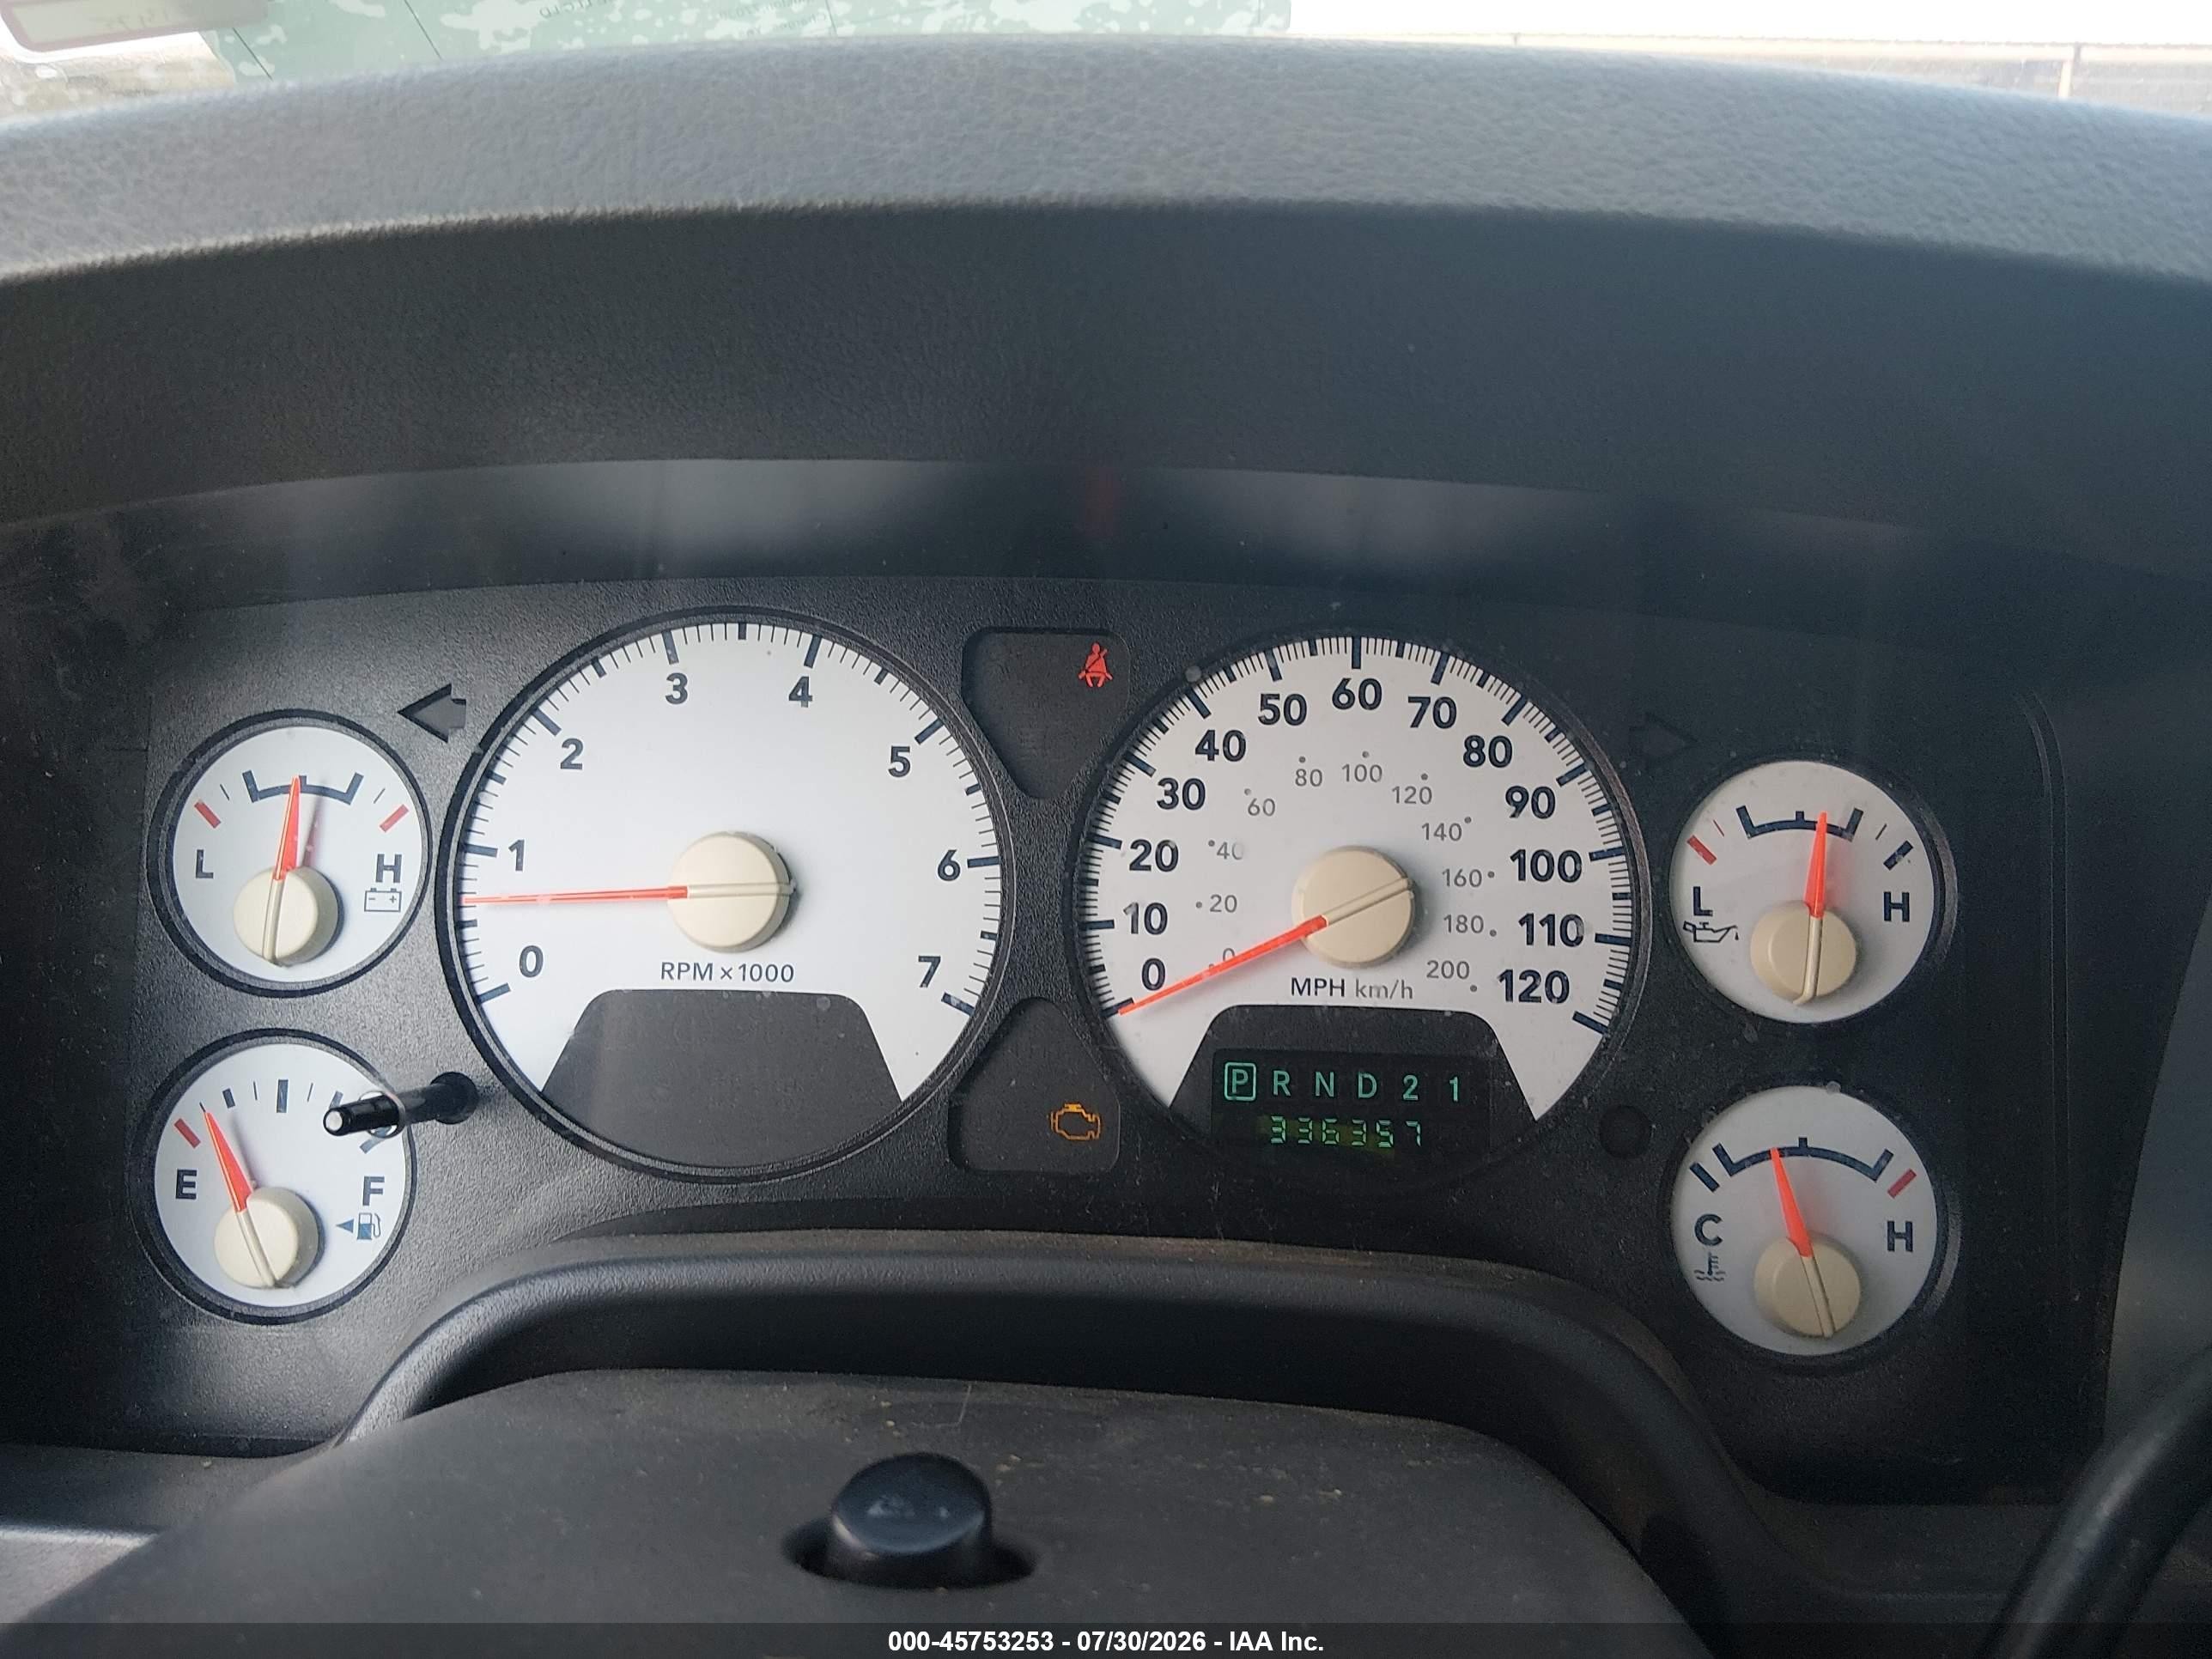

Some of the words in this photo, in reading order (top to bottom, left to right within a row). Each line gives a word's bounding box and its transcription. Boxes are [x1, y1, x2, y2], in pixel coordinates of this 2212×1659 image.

[665, 672, 689, 705] 3
[788, 676, 813, 708] 4
[1331, 678, 1382, 711] 60
[1257, 693, 1308, 726] 50
[1407, 696, 1457, 730] 70
[560, 738, 584, 770] 2
[888, 745, 911, 778] 5
[1194, 729, 1247, 763] 40
[1462, 734, 1513, 769] 80
[1295, 768, 1323, 787] 80
[1341, 763, 1382, 783] 100
[1156, 777, 1206, 811] 30
[1247, 798, 1276, 817] 60
[1391, 786, 1433, 805] 120
[1504, 785, 1556, 820] 90
[1421, 823, 1462, 842] 140
[195, 848, 214, 879] L
[507, 839, 525, 872] 1
[937, 849, 961, 882] 6
[1128, 838, 1179, 872] 20
[1216, 842, 1244, 860] 40
[1510, 848, 1583, 884] 100
[375, 854, 403, 884] H
[1442, 868, 1483, 888] 160
[1209, 894, 1237, 914] 20
[1692, 885, 1713, 917] L
[1883, 890, 1911, 923] H
[1122, 902, 1168, 935] 10
[1443, 914, 1485, 934] 180
[1518, 912, 1584, 948] 110
[519, 945, 544, 978] 0
[660, 962, 714, 981] RPM
[738, 963, 794, 983] 1000
[918, 955, 941, 988] 7
[1141, 957, 1166, 991] 0
[1425, 959, 1470, 980] 200
[1291, 977, 1346, 998] MPH
[1355, 978, 1413, 1000] km/h
[1498, 969, 1570, 1005] 120
[1231, 1068, 1249, 1094] P
[1273, 1070, 1291, 1097] R
[1315, 1071, 1334, 1097] N
[1358, 1073, 1377, 1098] D
[1402, 1074, 1419, 1101] 2
[1449, 1076, 1458, 1102] 1
[1270, 1115, 1421, 1148] 336357
[175, 1169, 198, 1200] E
[362, 1176, 386, 1206] F
[1694, 1213, 1723, 1247] C
[1887, 1220, 1914, 1253] H
